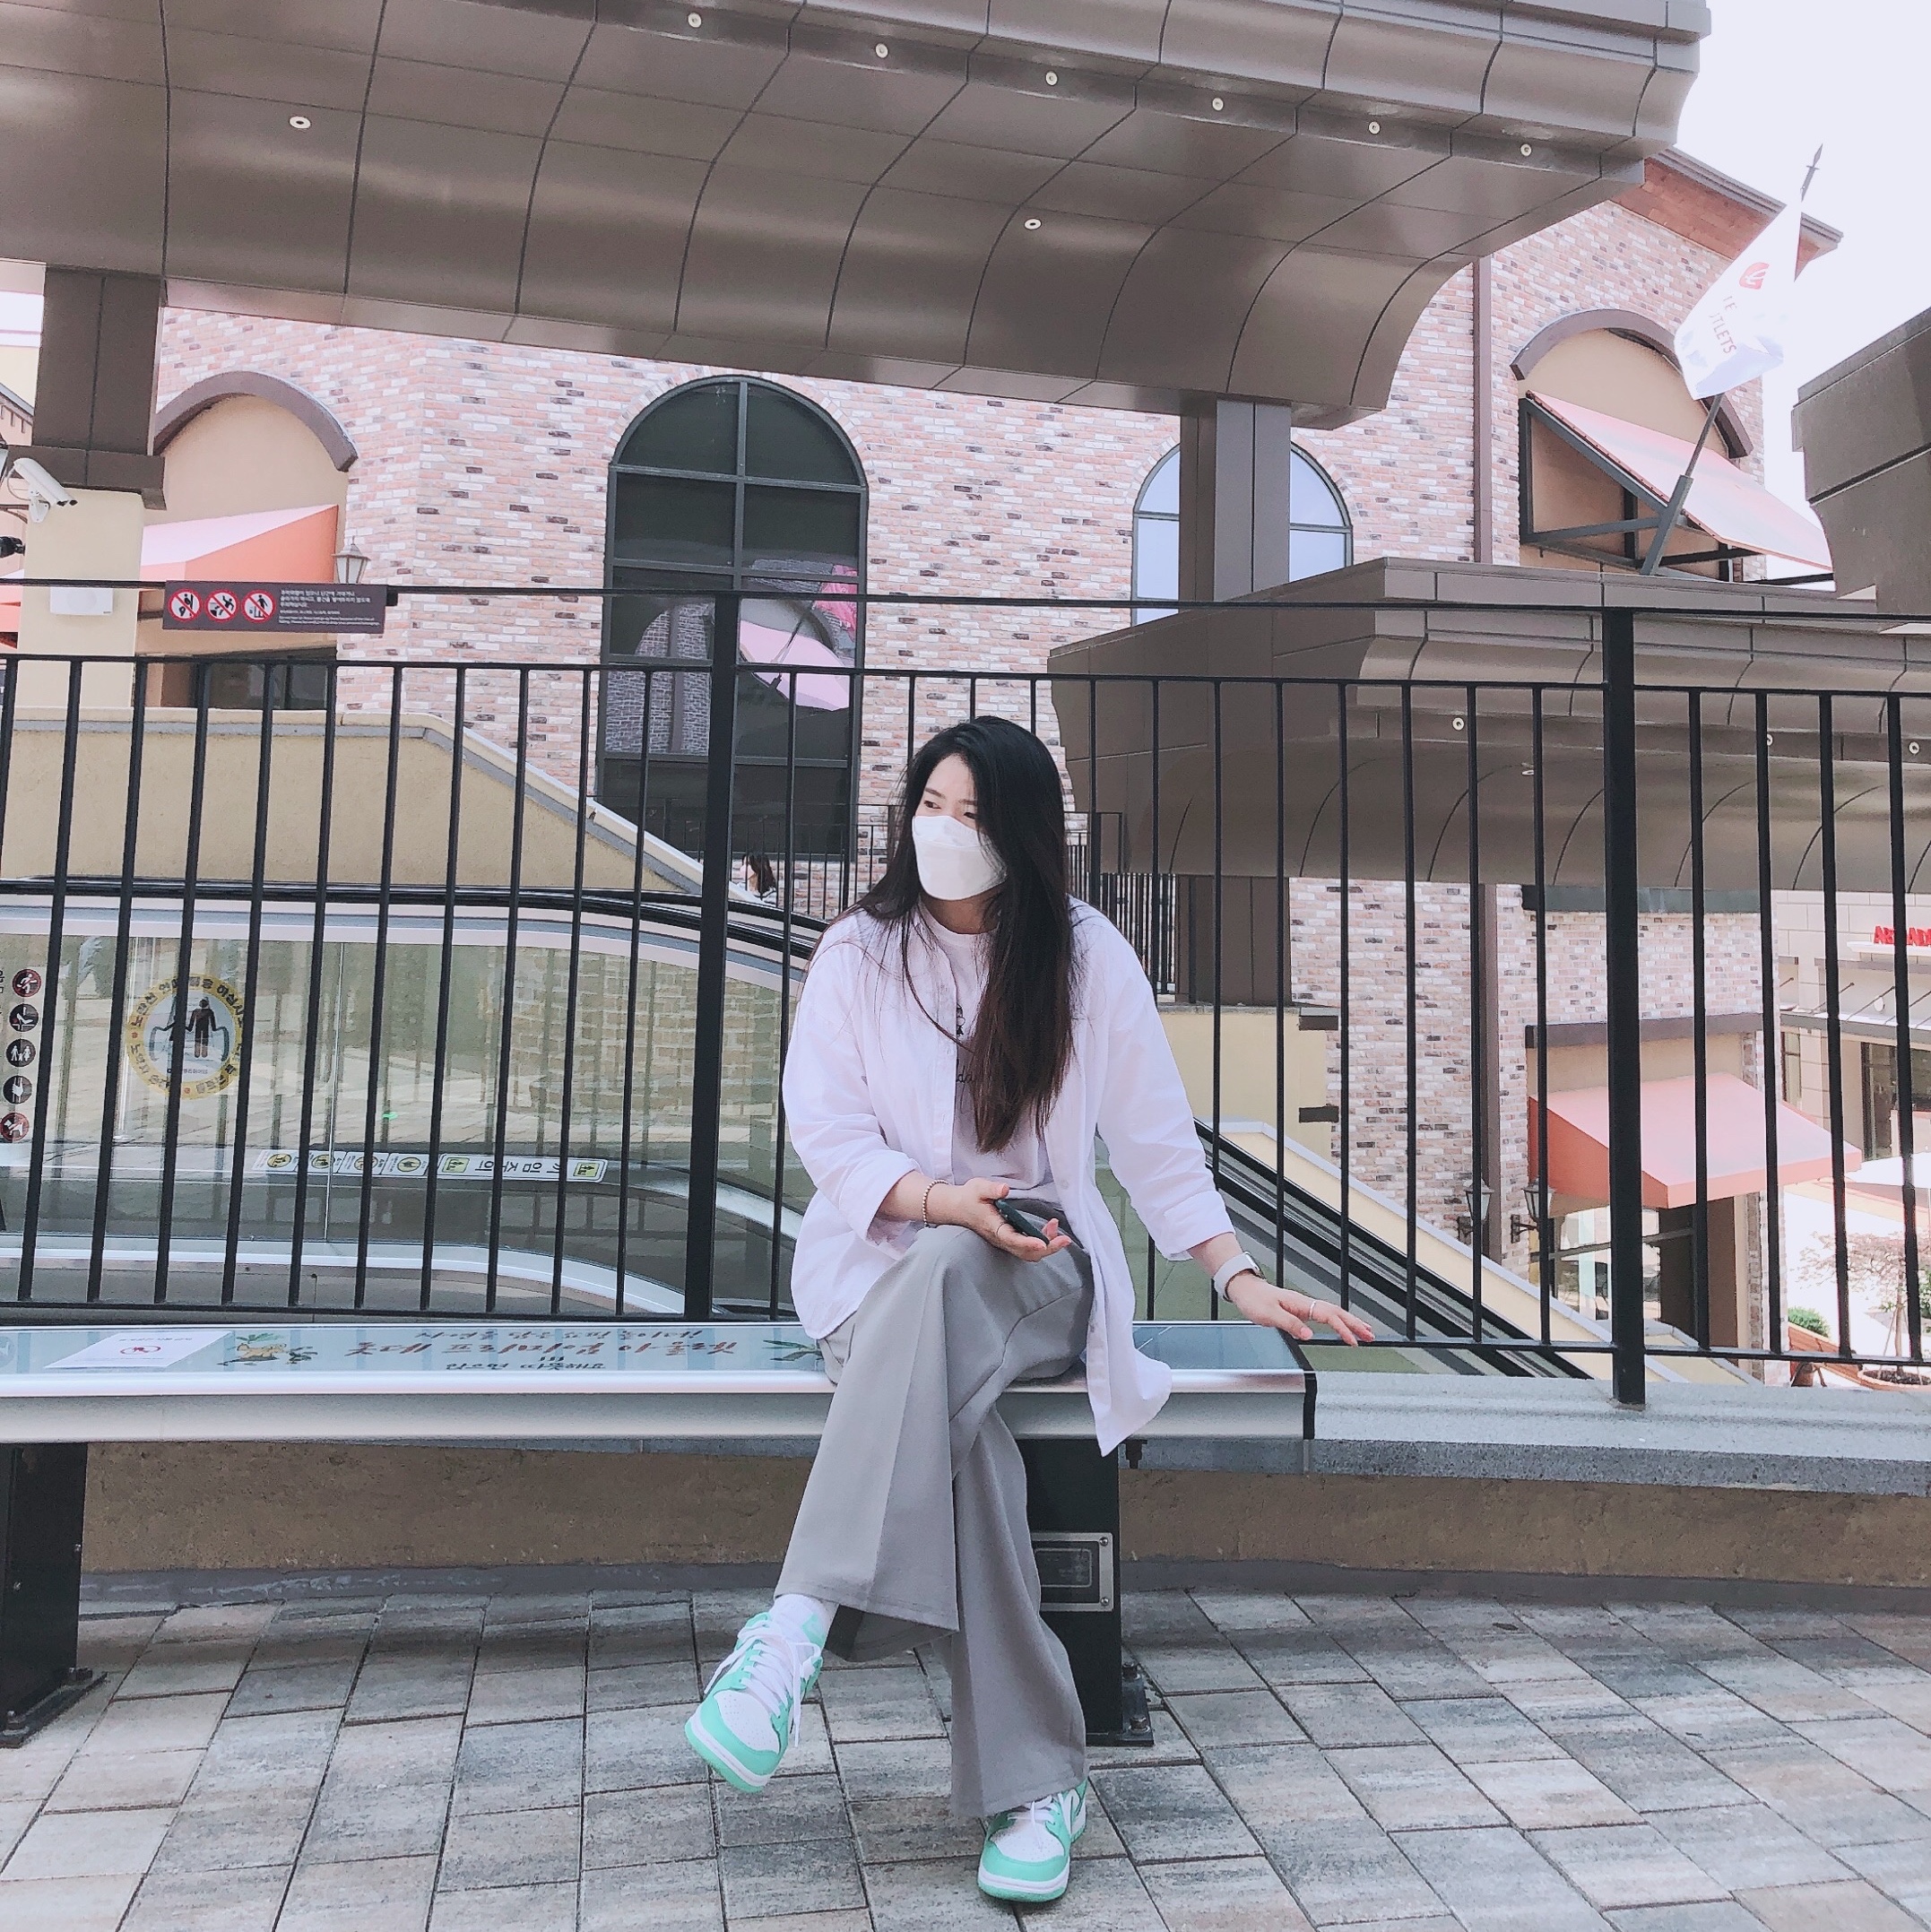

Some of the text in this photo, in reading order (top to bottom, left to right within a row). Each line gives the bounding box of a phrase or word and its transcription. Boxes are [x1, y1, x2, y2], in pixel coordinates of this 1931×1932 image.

[343, 1341, 738, 1356] 롯데 프리미엄 아울렛
